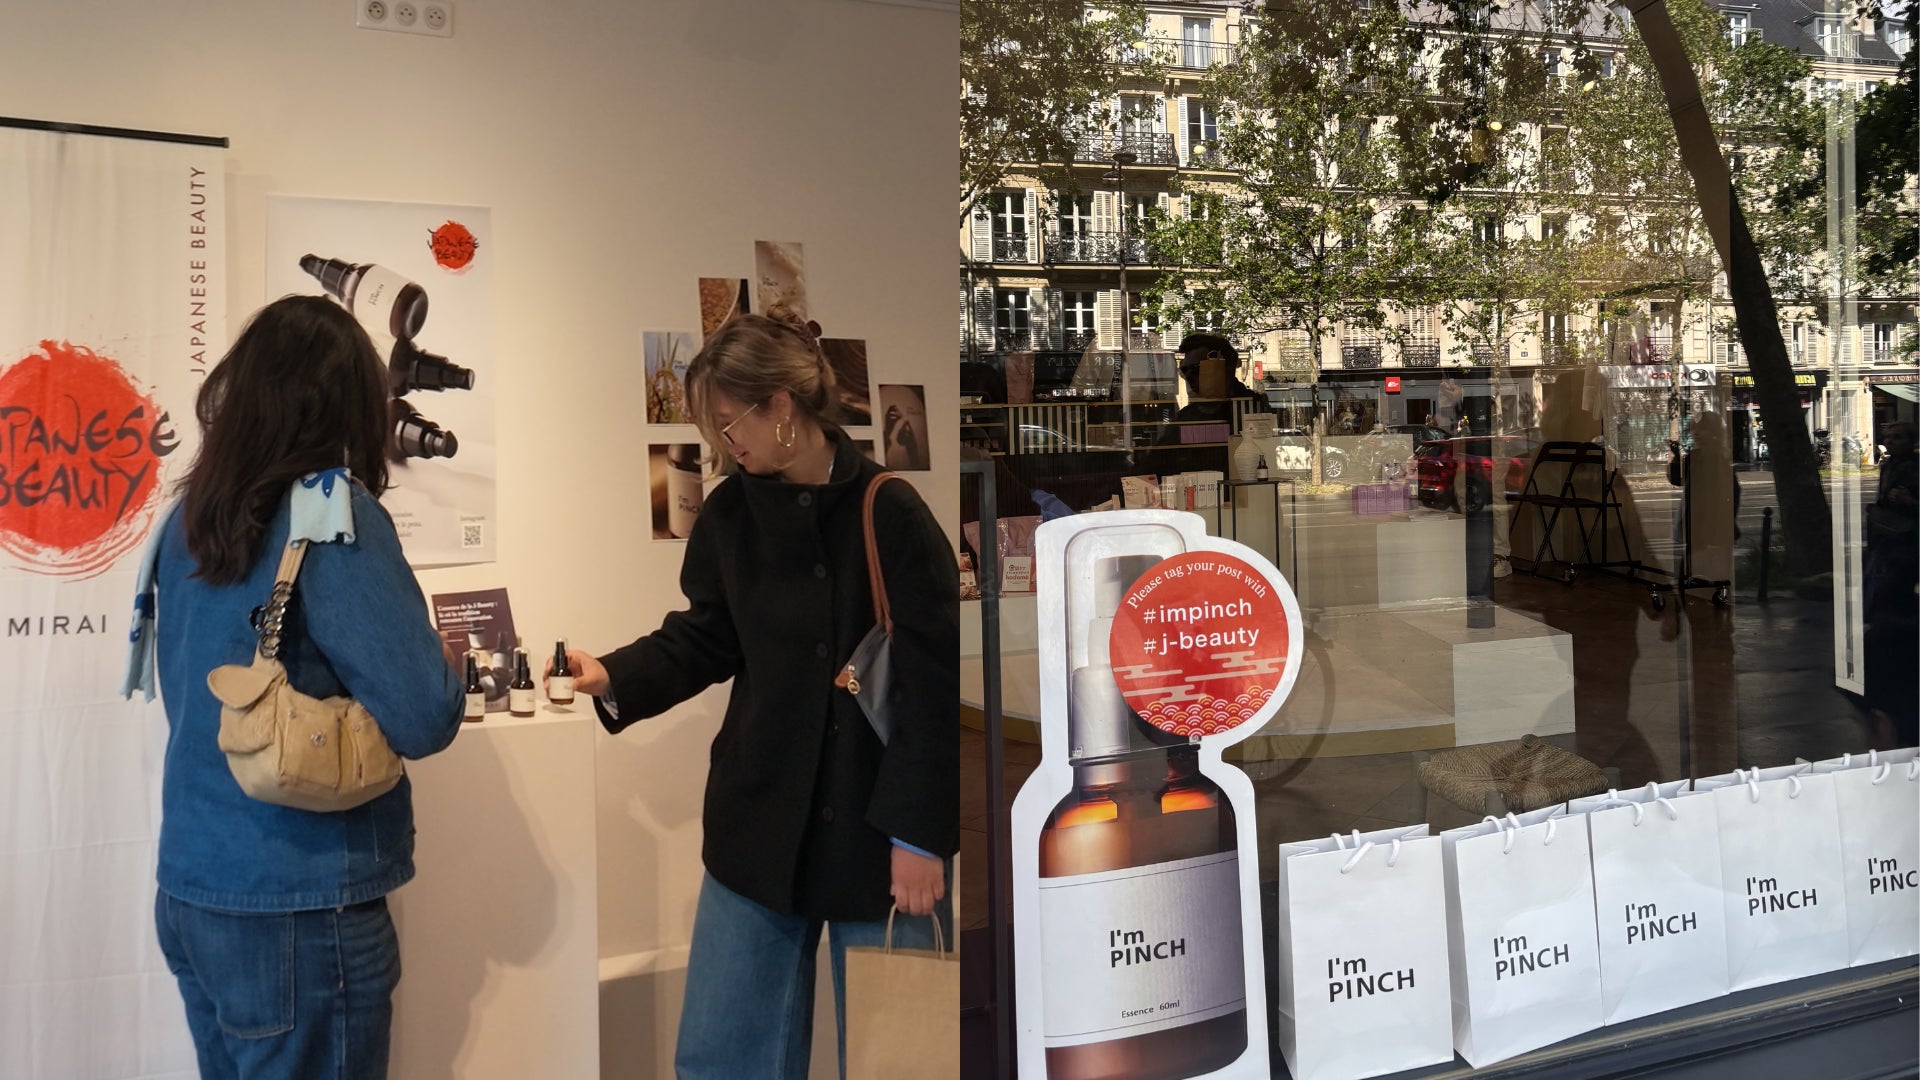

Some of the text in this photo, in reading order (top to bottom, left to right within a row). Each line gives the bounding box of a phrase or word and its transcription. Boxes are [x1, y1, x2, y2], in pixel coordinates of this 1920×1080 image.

[190, 167, 206, 376] JAPANESE BEAUTY
[0, 394, 182, 471] PANESE
[1127, 562, 1267, 609] Please tag your post with
[1143, 598, 1252, 625] #impinch
[8, 614, 107, 637] MIRAI
[1143, 627, 1260, 656] #j-beauty
[1867, 857, 1898, 876] I'm
[1746, 876, 1777, 896] I'm
[1869, 869, 1919, 895] PINC
[1625, 902, 1657, 923] I'm
[1748, 888, 1818, 917] PINCH
[1110, 929, 1145, 948] I'm
[1626, 911, 1697, 945] PINCH
[1110, 938, 1186, 968] PINCH
[1493, 935, 1528, 957] I'm
[1328, 957, 1367, 979] I'm
[1495, 943, 1570, 981] PINCH
[1329, 968, 1415, 1003] PINCH
[1121, 999, 1180, 1018] Essence 60ml
